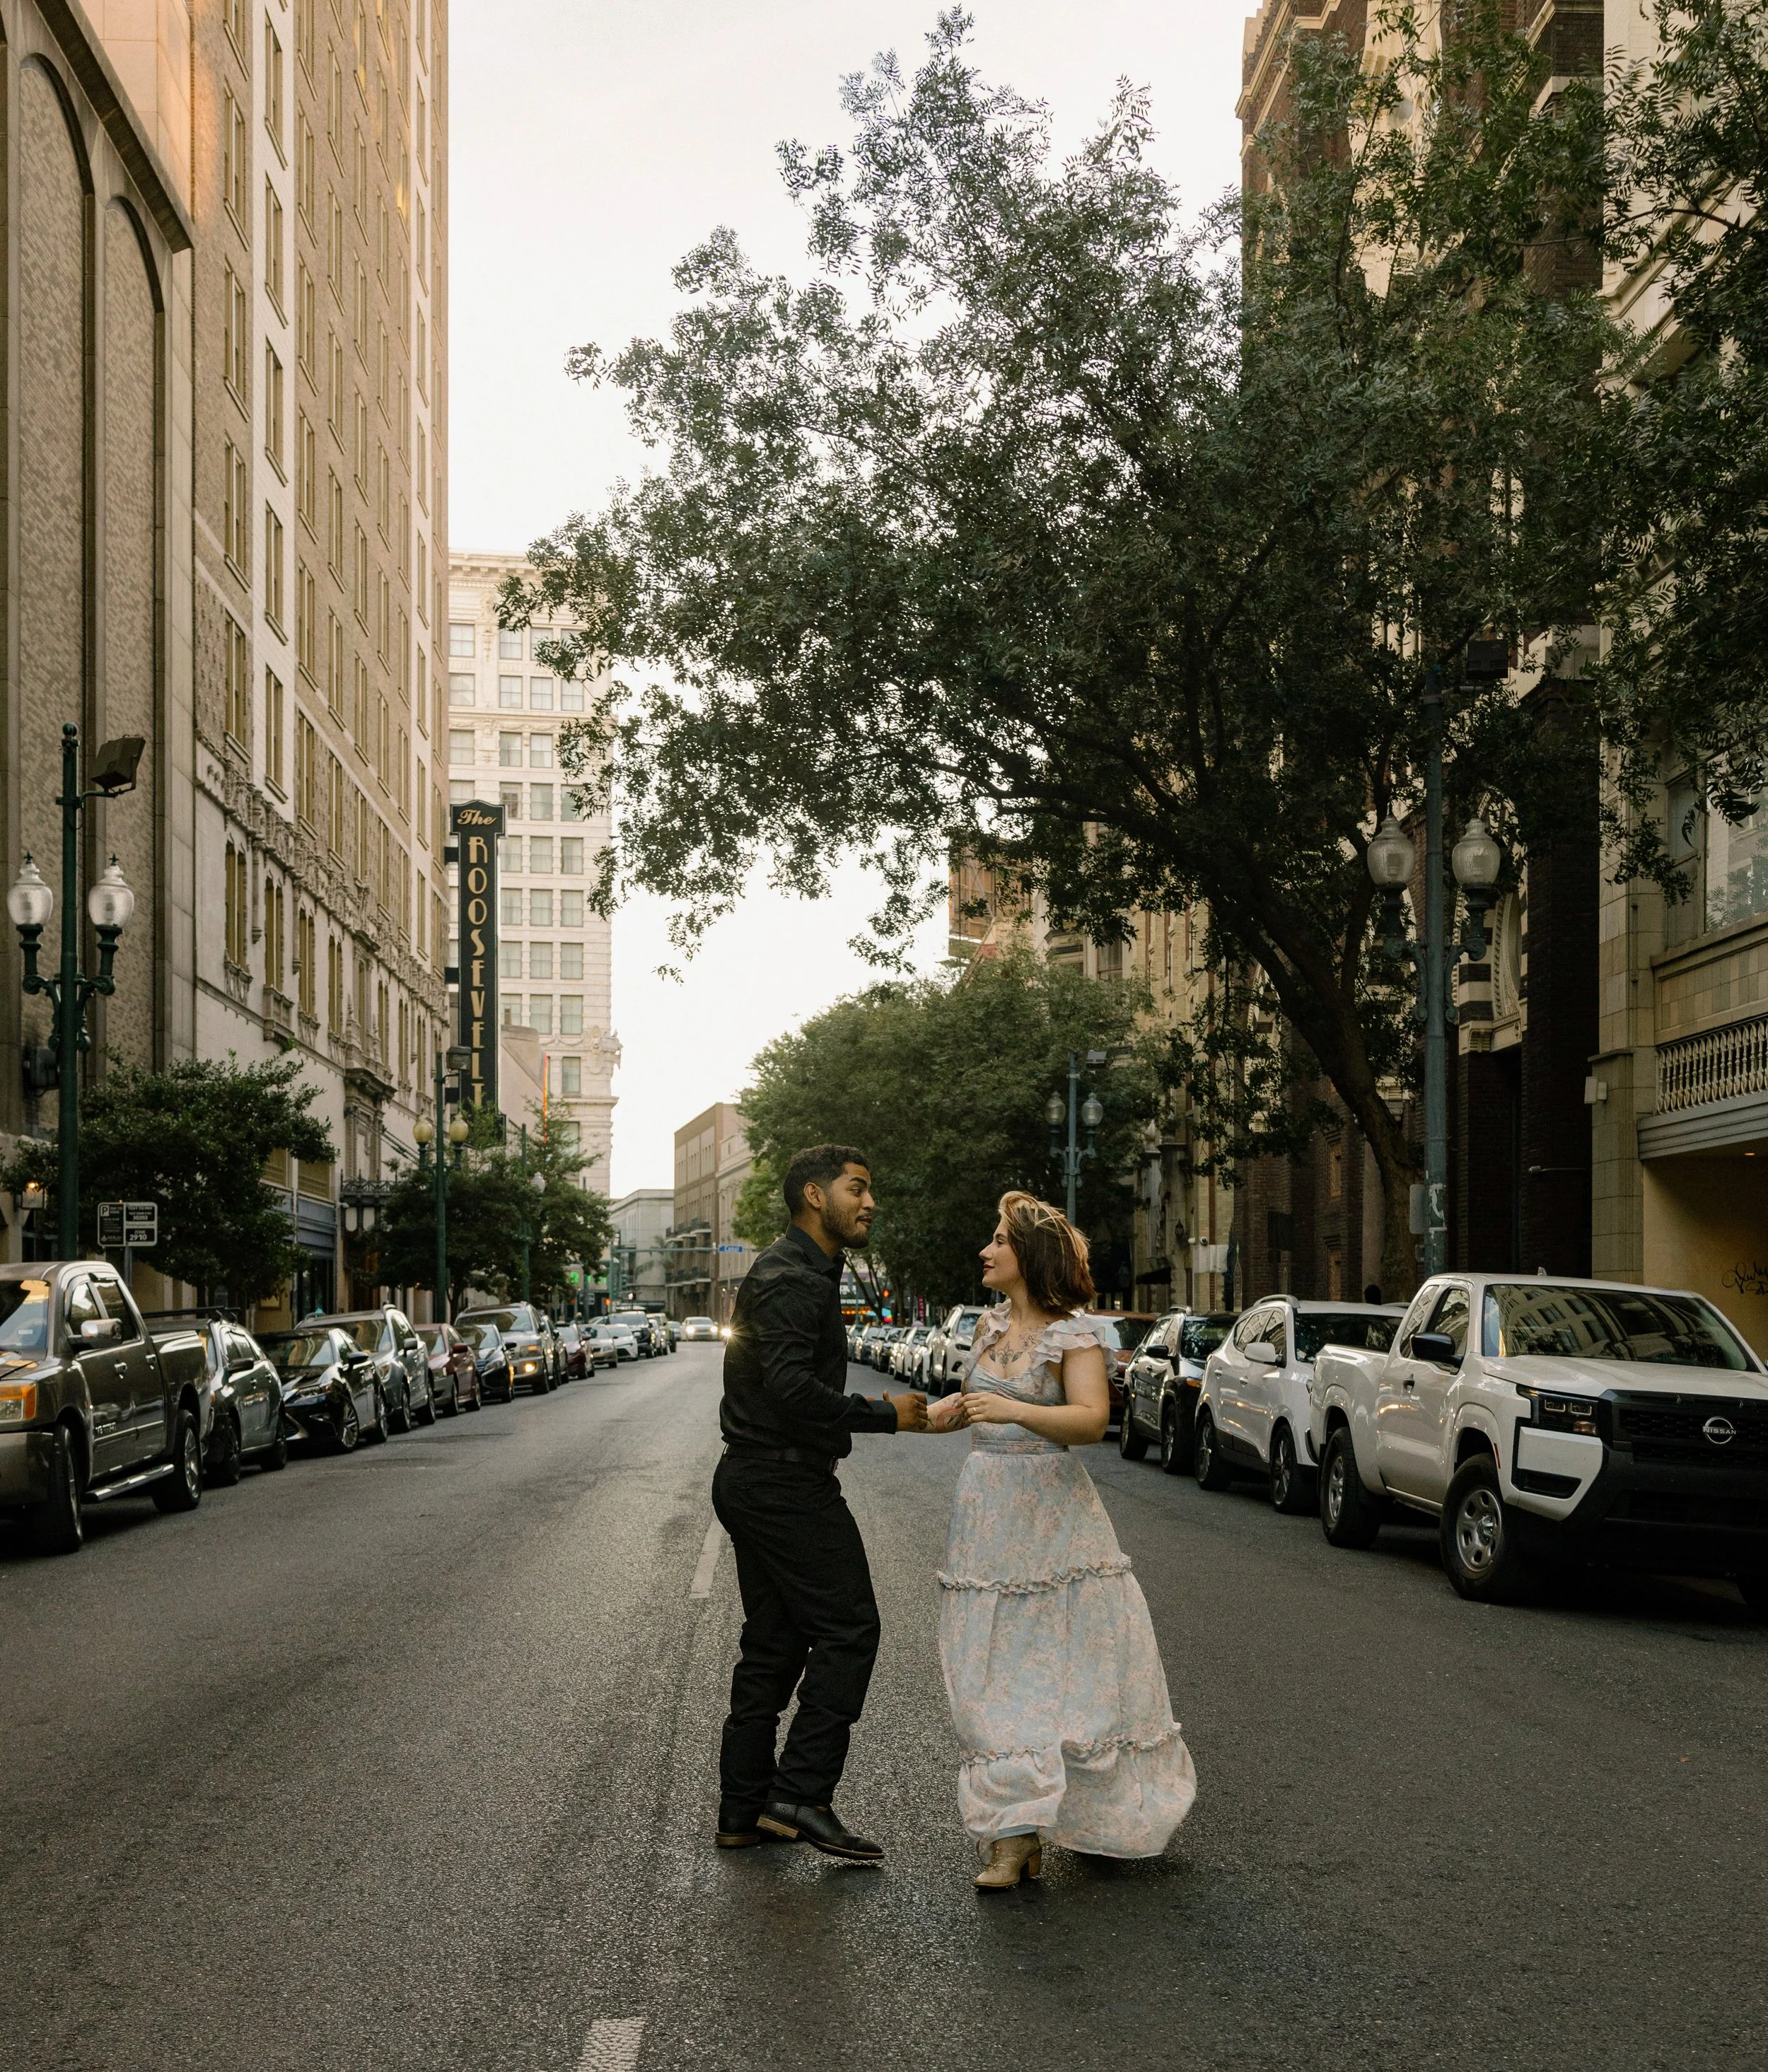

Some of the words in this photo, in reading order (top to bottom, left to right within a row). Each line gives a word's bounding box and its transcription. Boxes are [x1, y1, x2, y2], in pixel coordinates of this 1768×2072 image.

[457, 810, 496, 825] The
[467, 837, 489, 1108] ROOSEVELT
[102, 1206, 107, 1215] P
[1703, 1426, 1736, 1435] NISSAN
